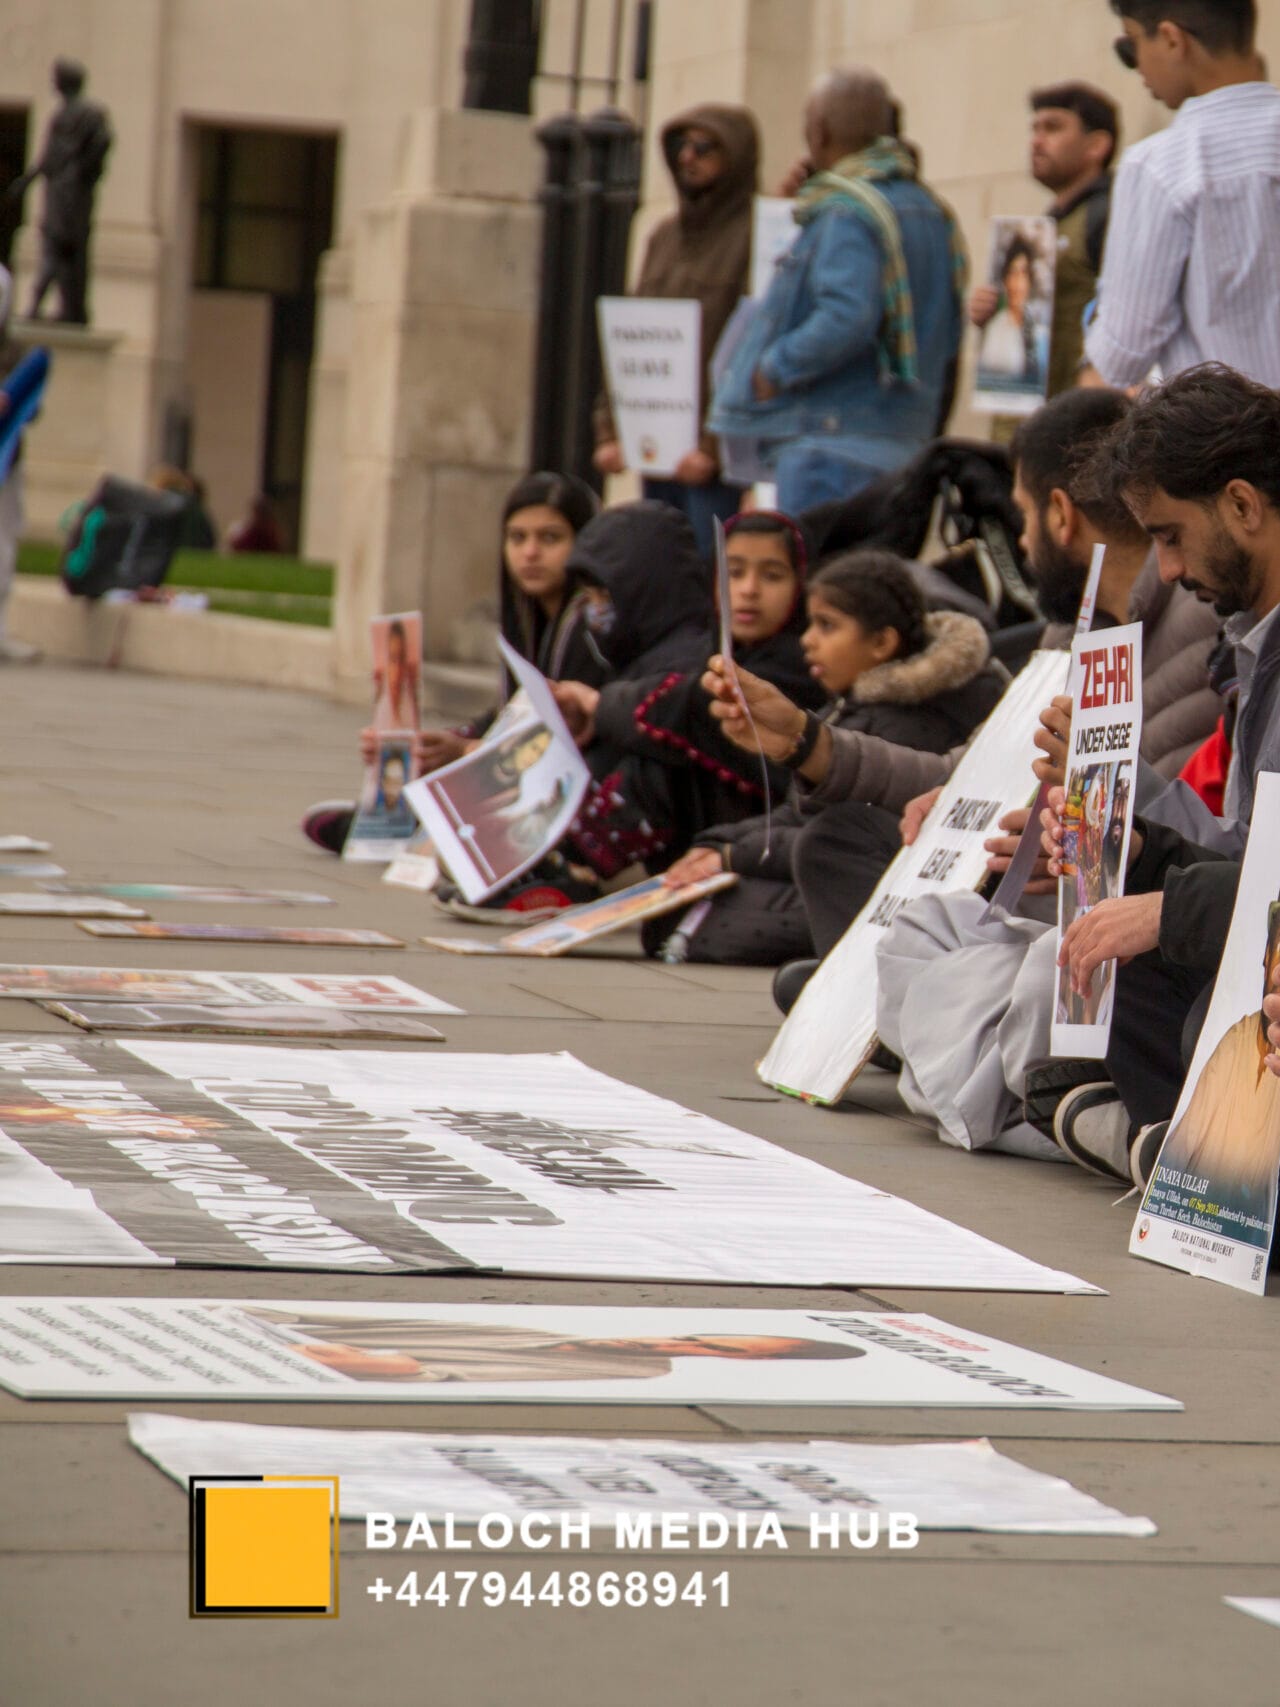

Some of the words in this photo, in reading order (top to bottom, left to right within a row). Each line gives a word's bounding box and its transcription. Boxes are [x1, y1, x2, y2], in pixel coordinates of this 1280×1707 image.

[1079, 643, 1133, 710] ZEHRI
[1075, 725, 1105, 755] UNDER
[1105, 722, 1132, 752] SIEGE
[918, 848, 962, 881] LEAVE
[1157, 1166, 1182, 1187] INAYA
[1181, 1173, 1210, 1195] ULLAH
